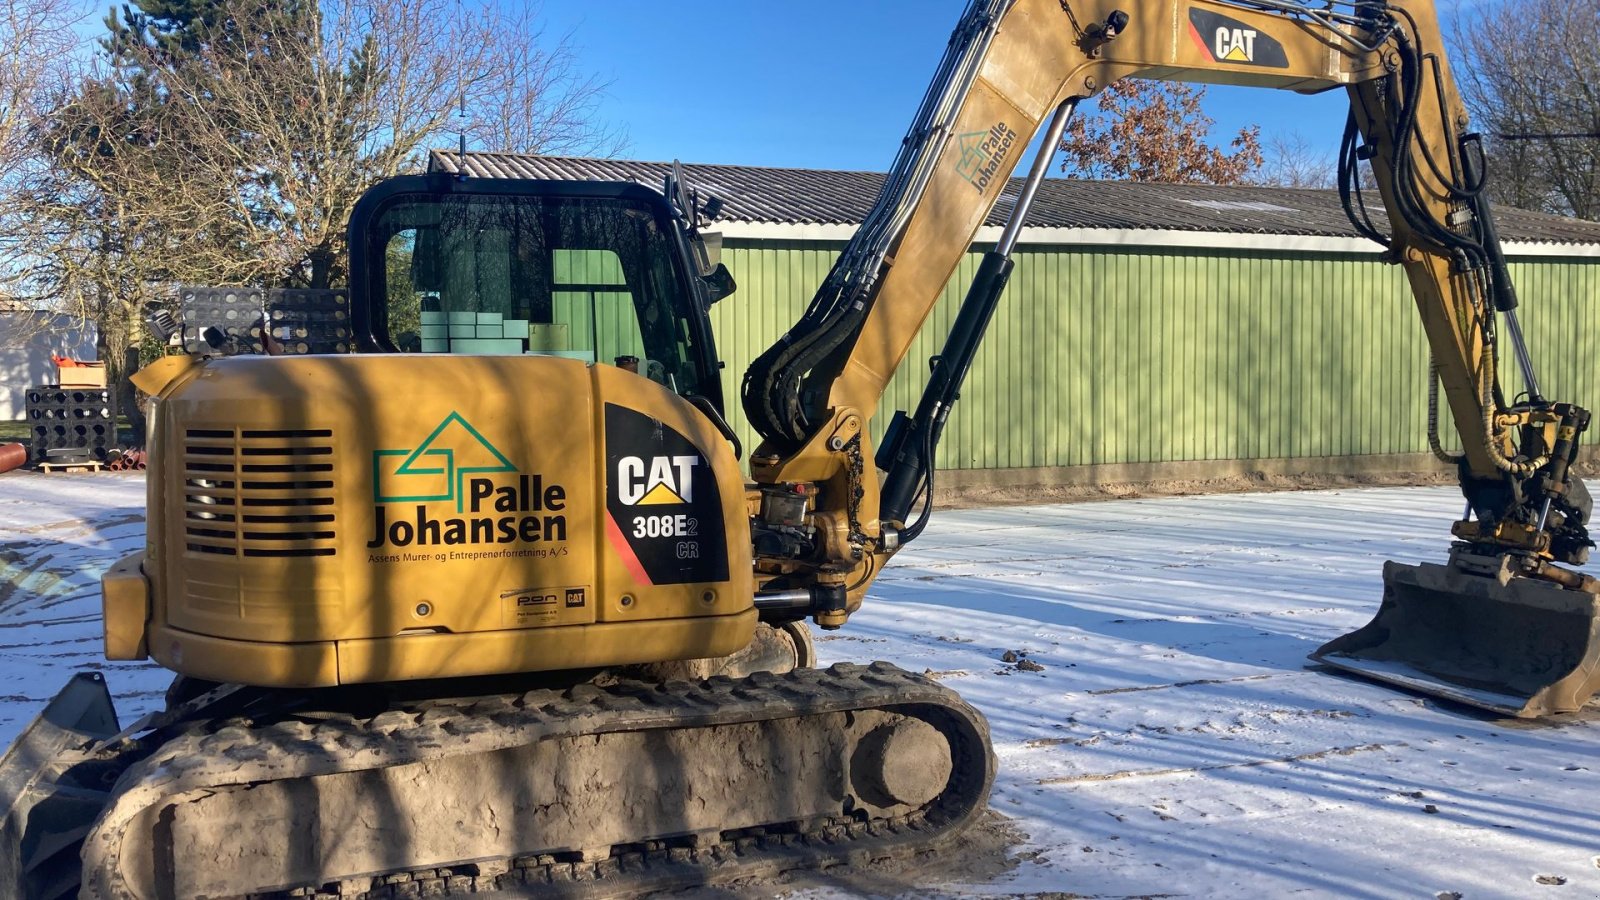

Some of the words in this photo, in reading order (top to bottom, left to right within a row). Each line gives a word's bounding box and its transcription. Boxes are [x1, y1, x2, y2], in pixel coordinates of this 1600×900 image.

[1216, 26, 1256, 62] CAT
[981, 121, 1008, 157] Palle
[971, 129, 1017, 196] Johansen
[470, 475, 566, 513] Palle
[618, 455, 698, 506] CAT
[367, 505, 566, 548] Johansen
[368, 554, 400, 563] Assens
[403, 552, 433, 562] Murer-
[435, 553, 447, 563] og
[449, 547, 547, 561] Entreprenørforretning
[549, 546, 568, 558] A/S
[676, 541, 699, 559] CR
[567, 593, 583, 604] CAT
